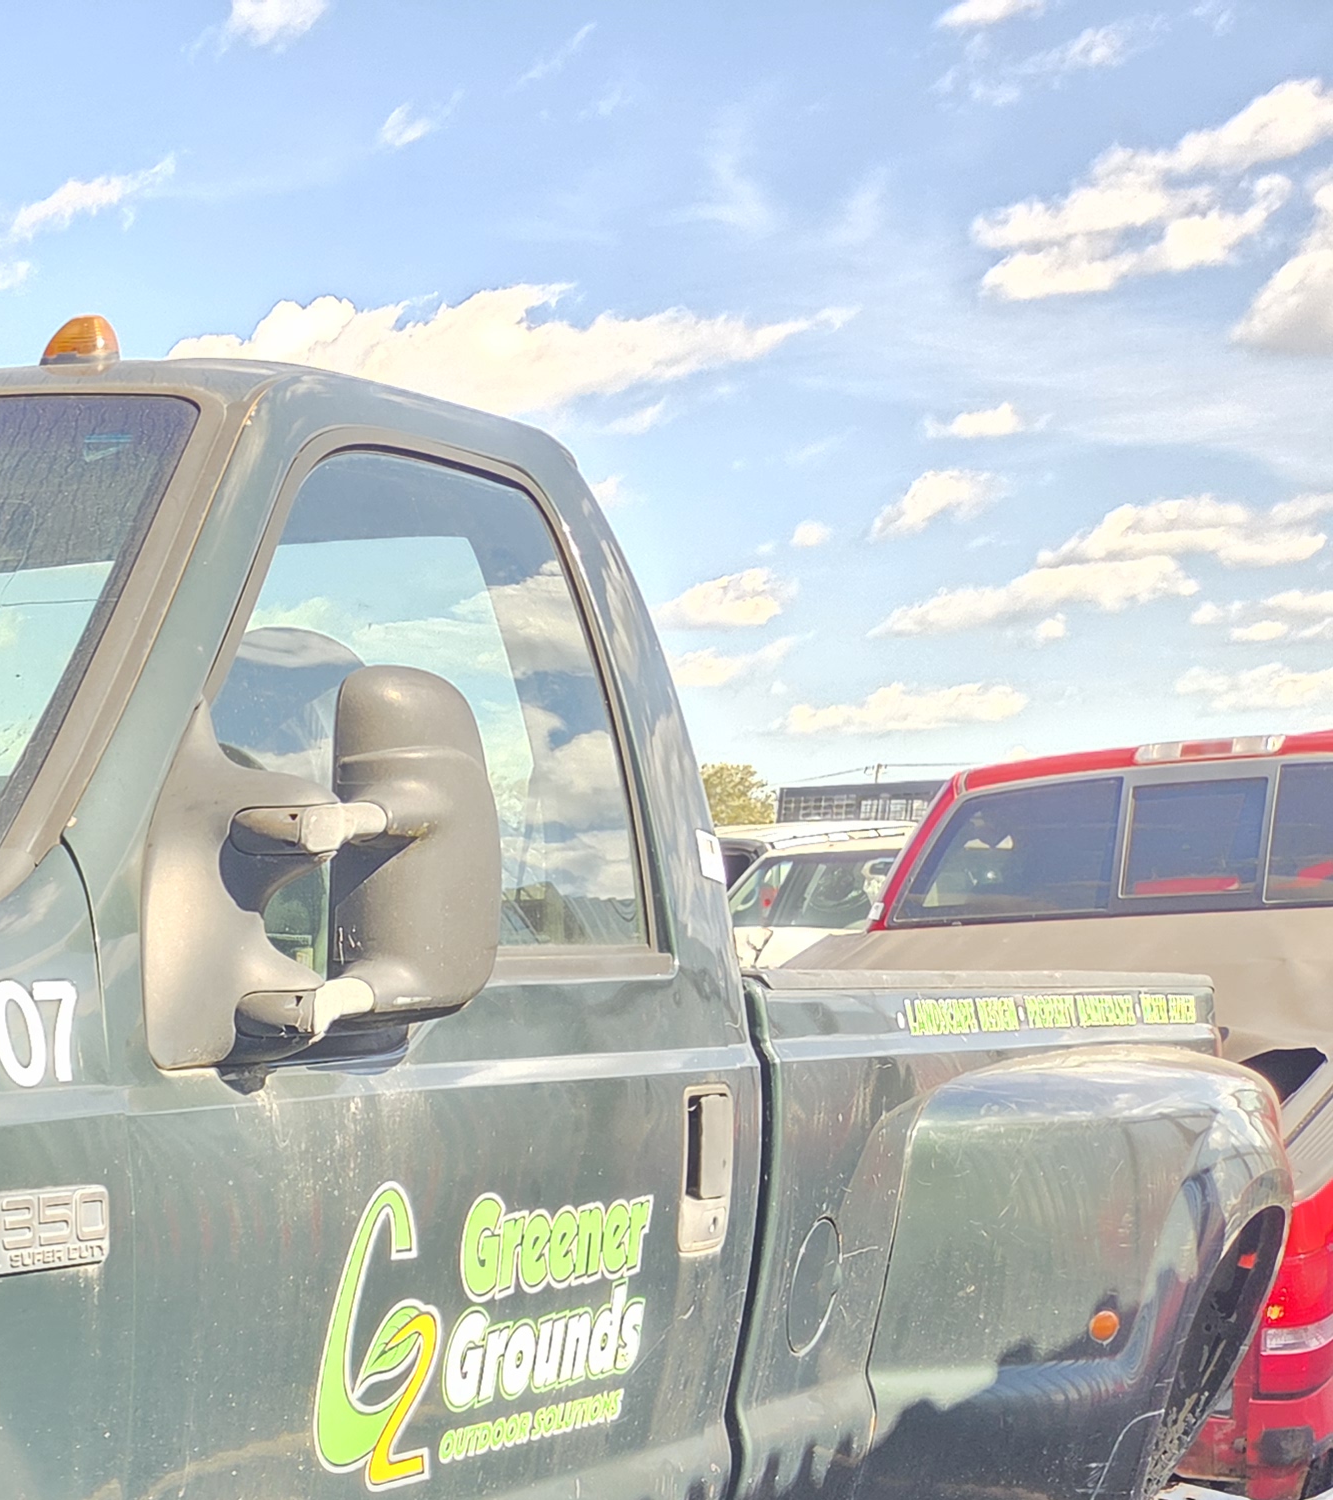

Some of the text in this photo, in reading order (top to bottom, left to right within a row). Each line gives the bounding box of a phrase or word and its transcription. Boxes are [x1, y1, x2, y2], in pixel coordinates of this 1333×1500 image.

[9, 1248, 63, 1268] SUPER
[66, 1243, 106, 1261] DUTY
[460, 1192, 654, 1303] Greener
[441, 1279, 647, 1413] Grounds
[438, 1387, 625, 1464] OUTDOOR SOLUTIONS
